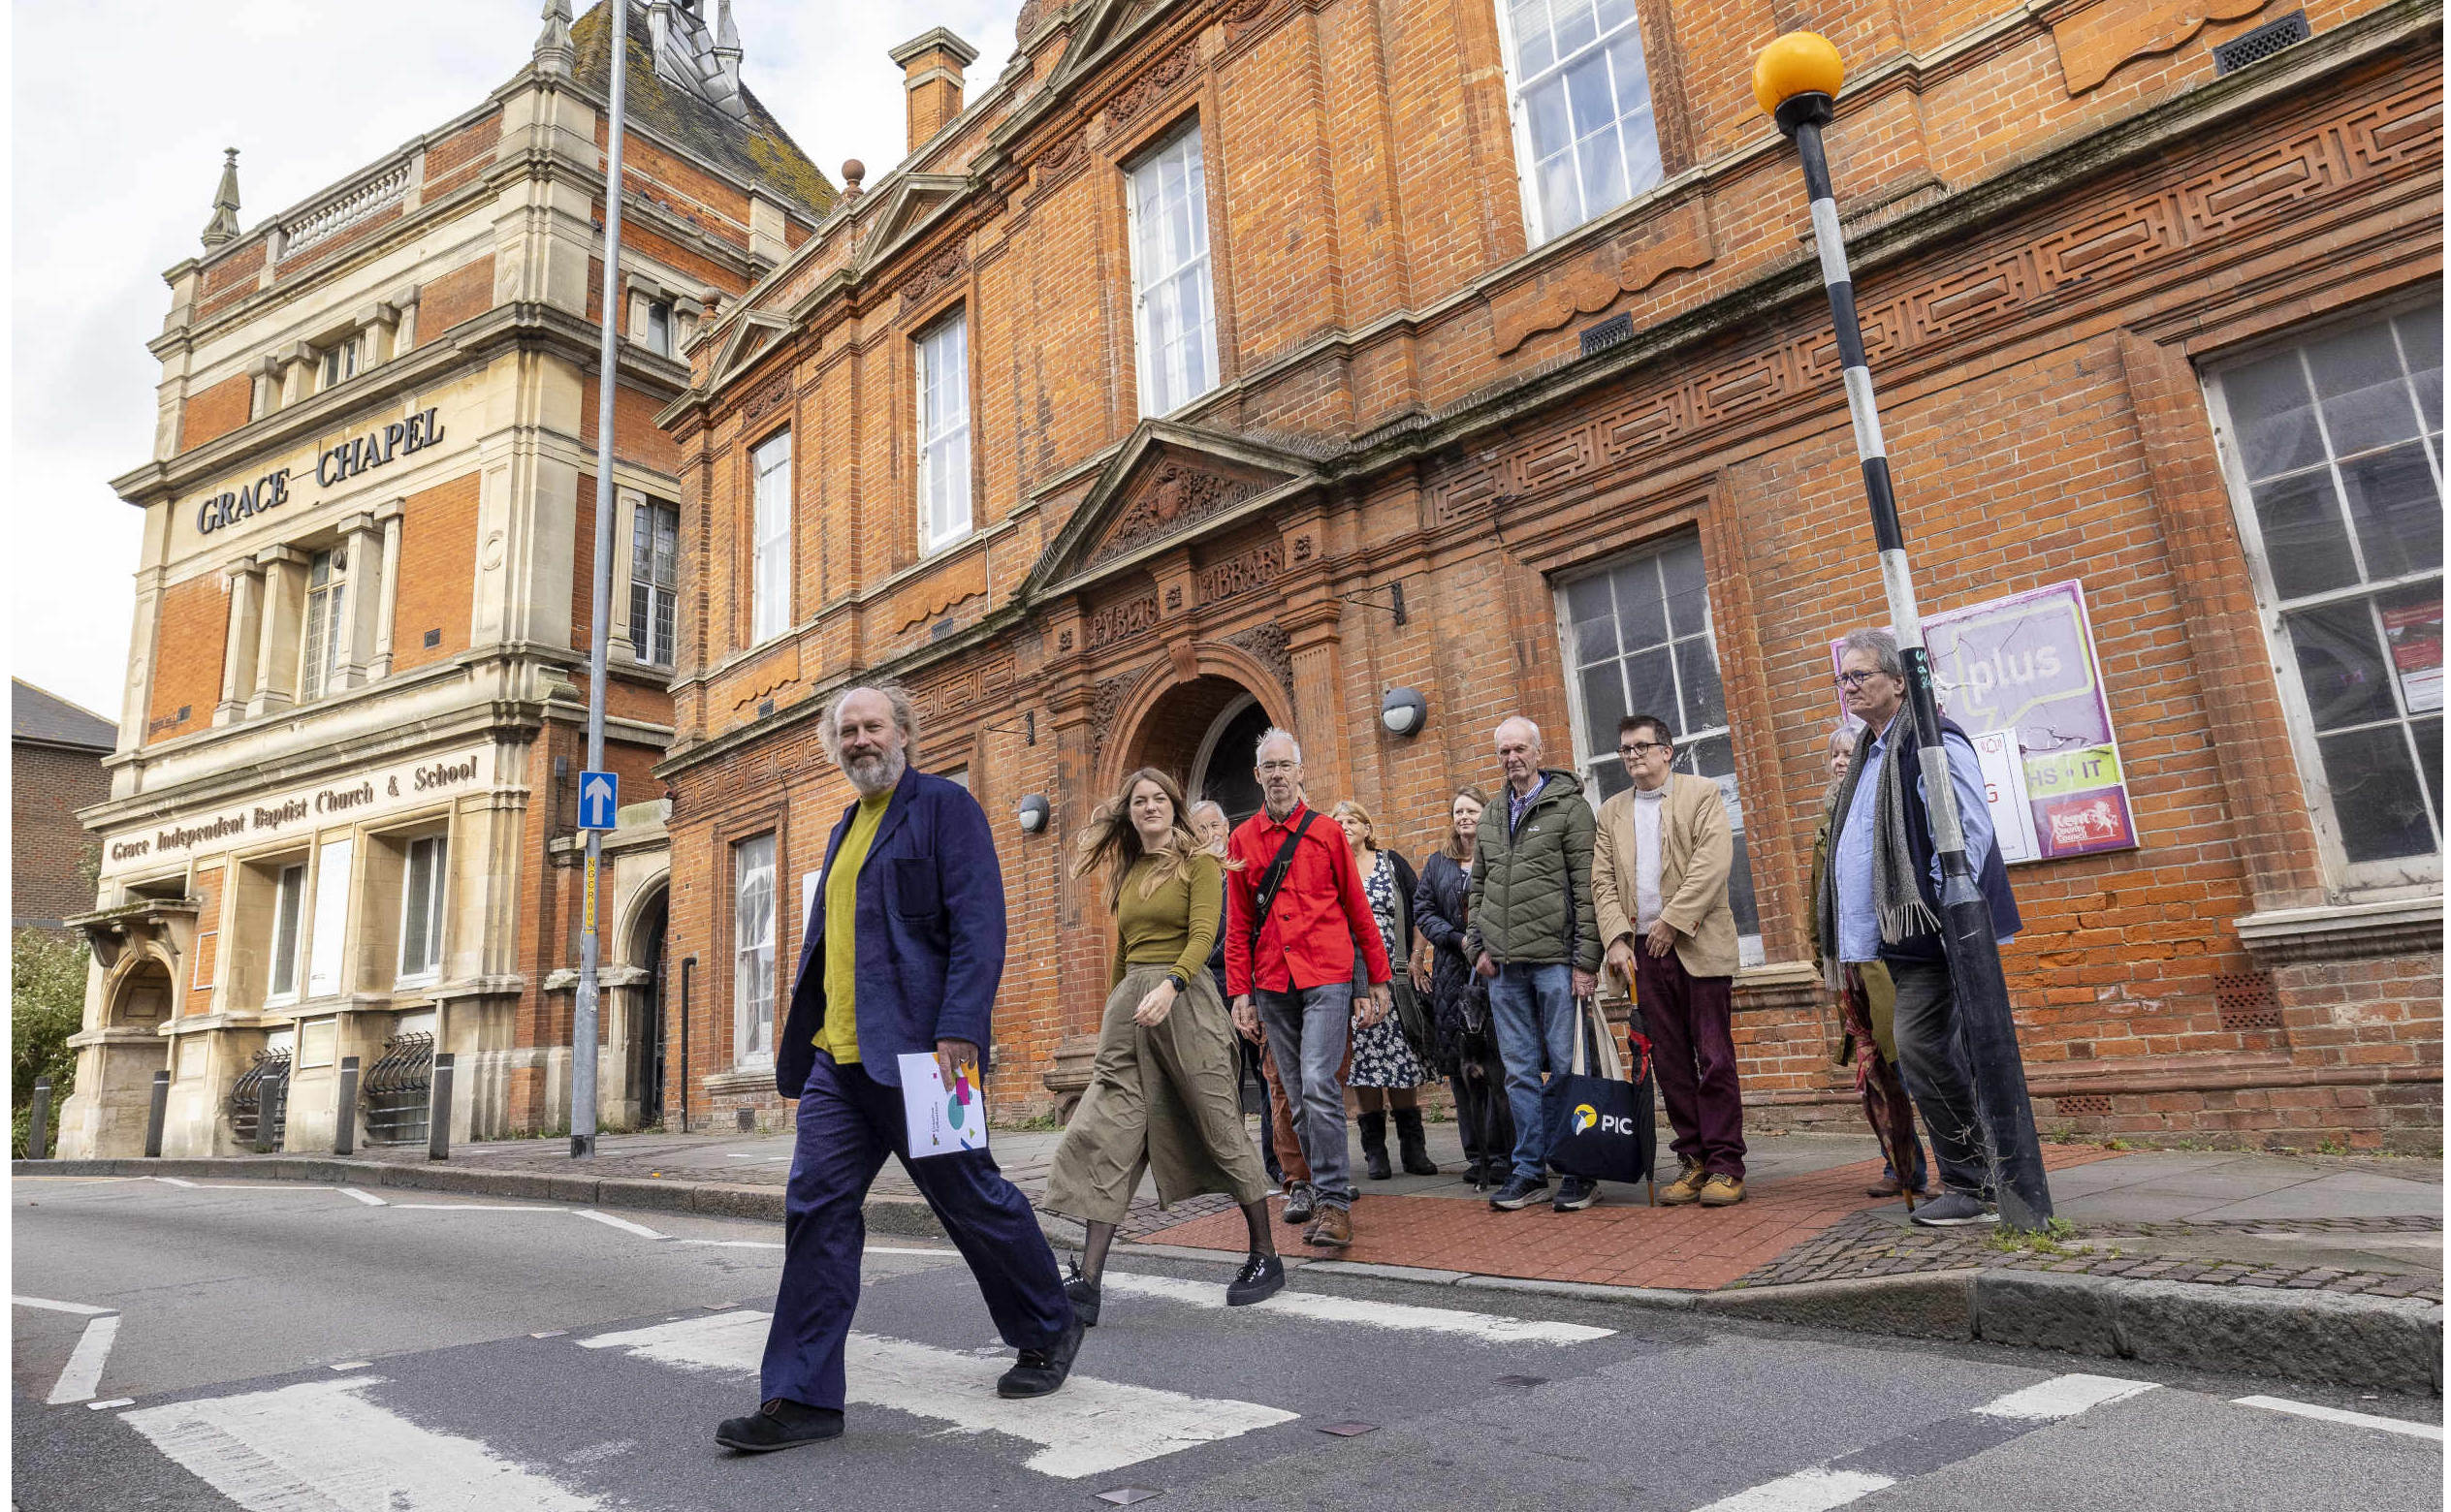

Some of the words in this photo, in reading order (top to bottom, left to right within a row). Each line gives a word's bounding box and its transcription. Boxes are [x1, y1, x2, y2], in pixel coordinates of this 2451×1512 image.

[197, 467, 290, 534] GRACE
[315, 407, 445, 488] CHAPEL
[1198, 546, 1285, 604] LIBRARY
[1968, 646, 2062, 705] plus
[2083, 759, 2102, 778] IT
[111, 839, 150, 862] Grace
[156, 813, 245, 850] Independent
[252, 798, 307, 830] Baptist
[315, 781, 374, 814] Church
[387, 774, 399, 798] &
[414, 755, 477, 791] School
[2051, 811, 2091, 829] Kent
[2054, 825, 2086, 836] County
[2056, 832, 2087, 844] Council
[1601, 1115, 1634, 1135] PIC
